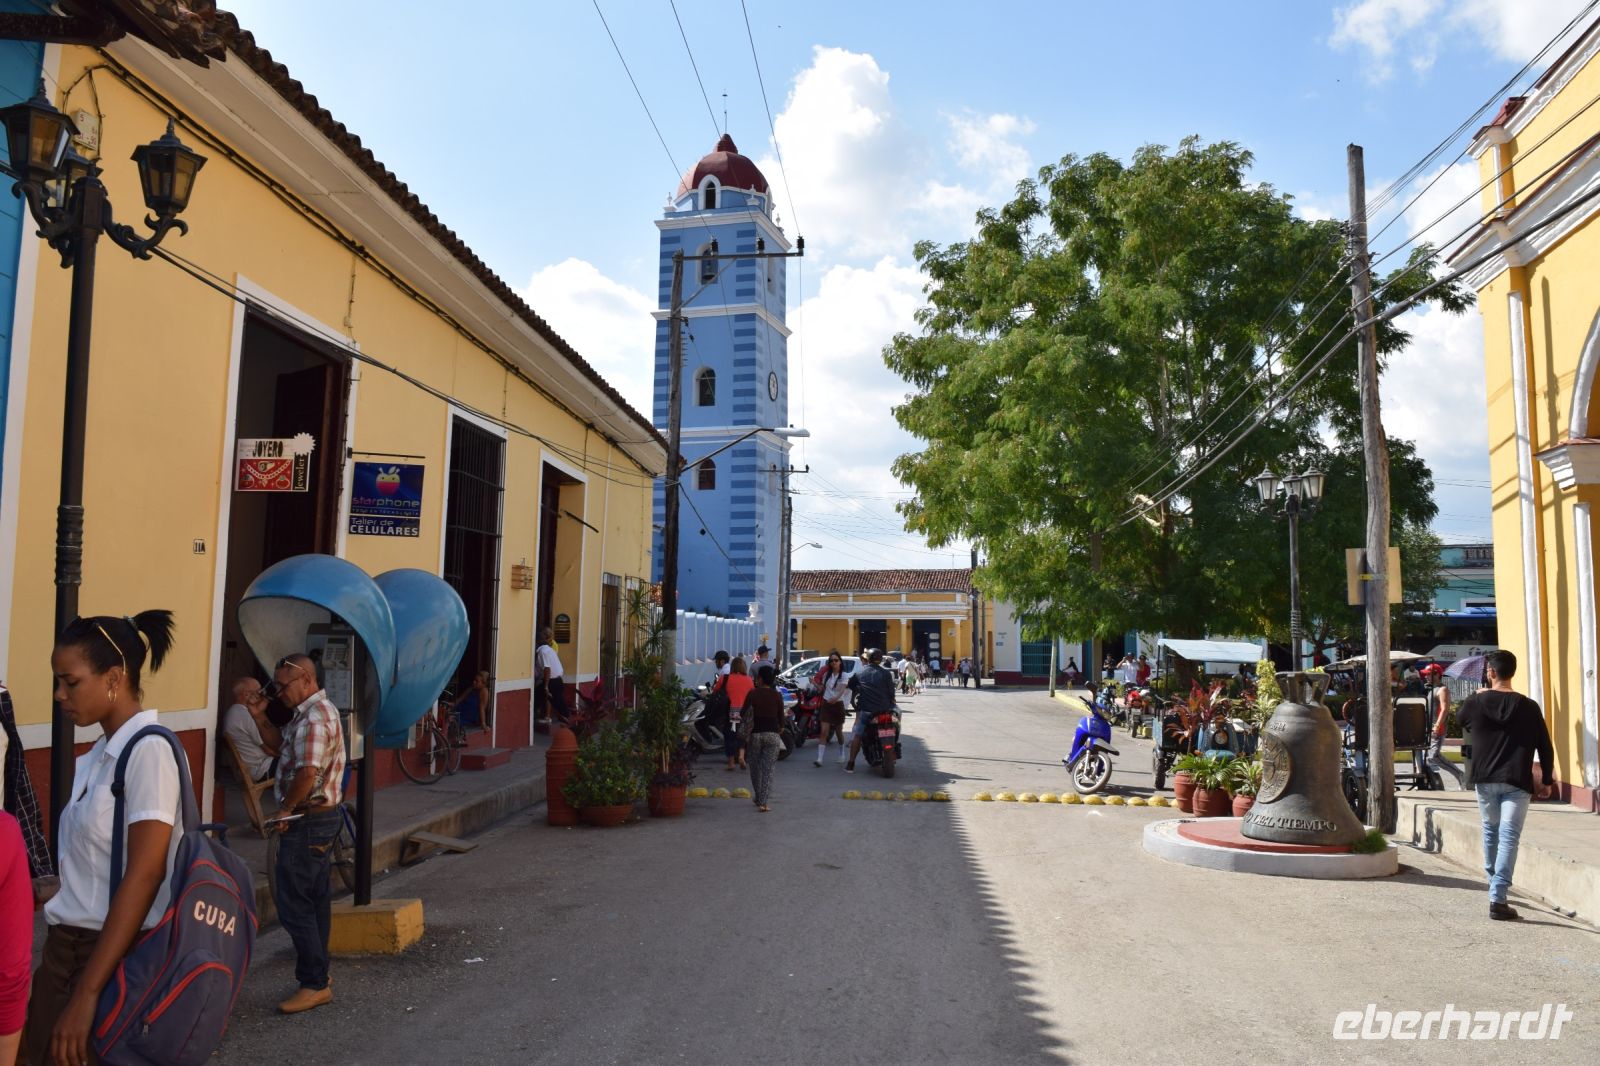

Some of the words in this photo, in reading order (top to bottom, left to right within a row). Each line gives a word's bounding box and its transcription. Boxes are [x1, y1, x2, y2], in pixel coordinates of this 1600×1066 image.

[252, 441, 283, 458] JOYERO
[294, 458, 305, 490] Jeweler
[352, 496, 420, 508] starphone
[350, 517, 377, 525] Taller
[350, 524, 418, 536] CELULARES
[1278, 817, 1337, 832] TIEMPO
[194, 900, 236, 937] CUBA
